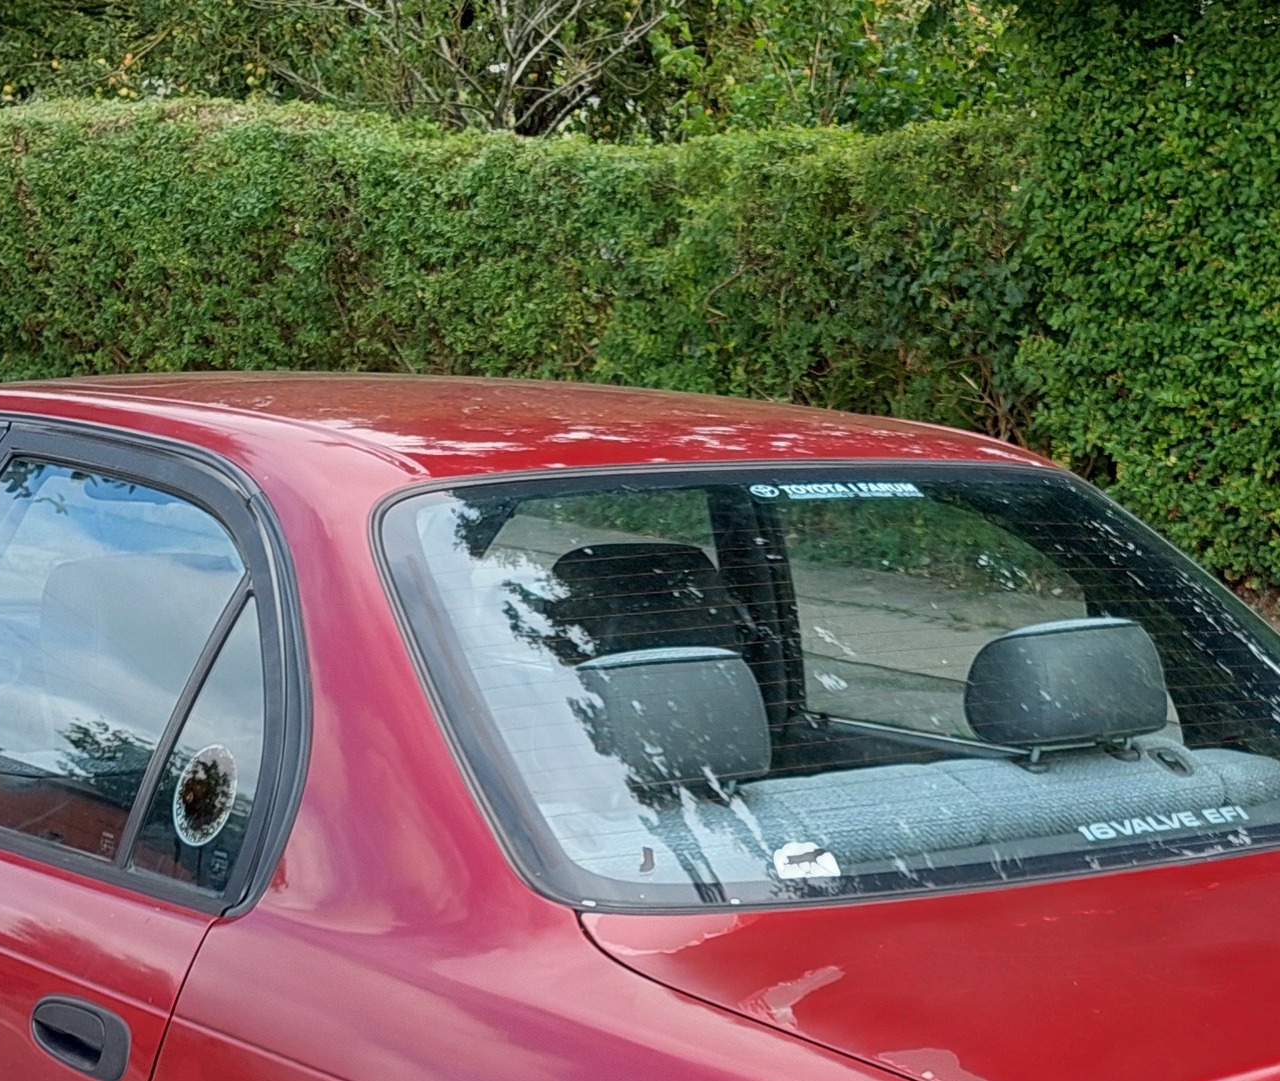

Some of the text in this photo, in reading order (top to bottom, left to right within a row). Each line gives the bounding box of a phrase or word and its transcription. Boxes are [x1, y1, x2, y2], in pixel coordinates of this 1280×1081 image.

[778, 482, 847, 495] TOYOTA
[858, 482, 919, 494] FARUM
[1202, 805, 1250, 824] EFI
